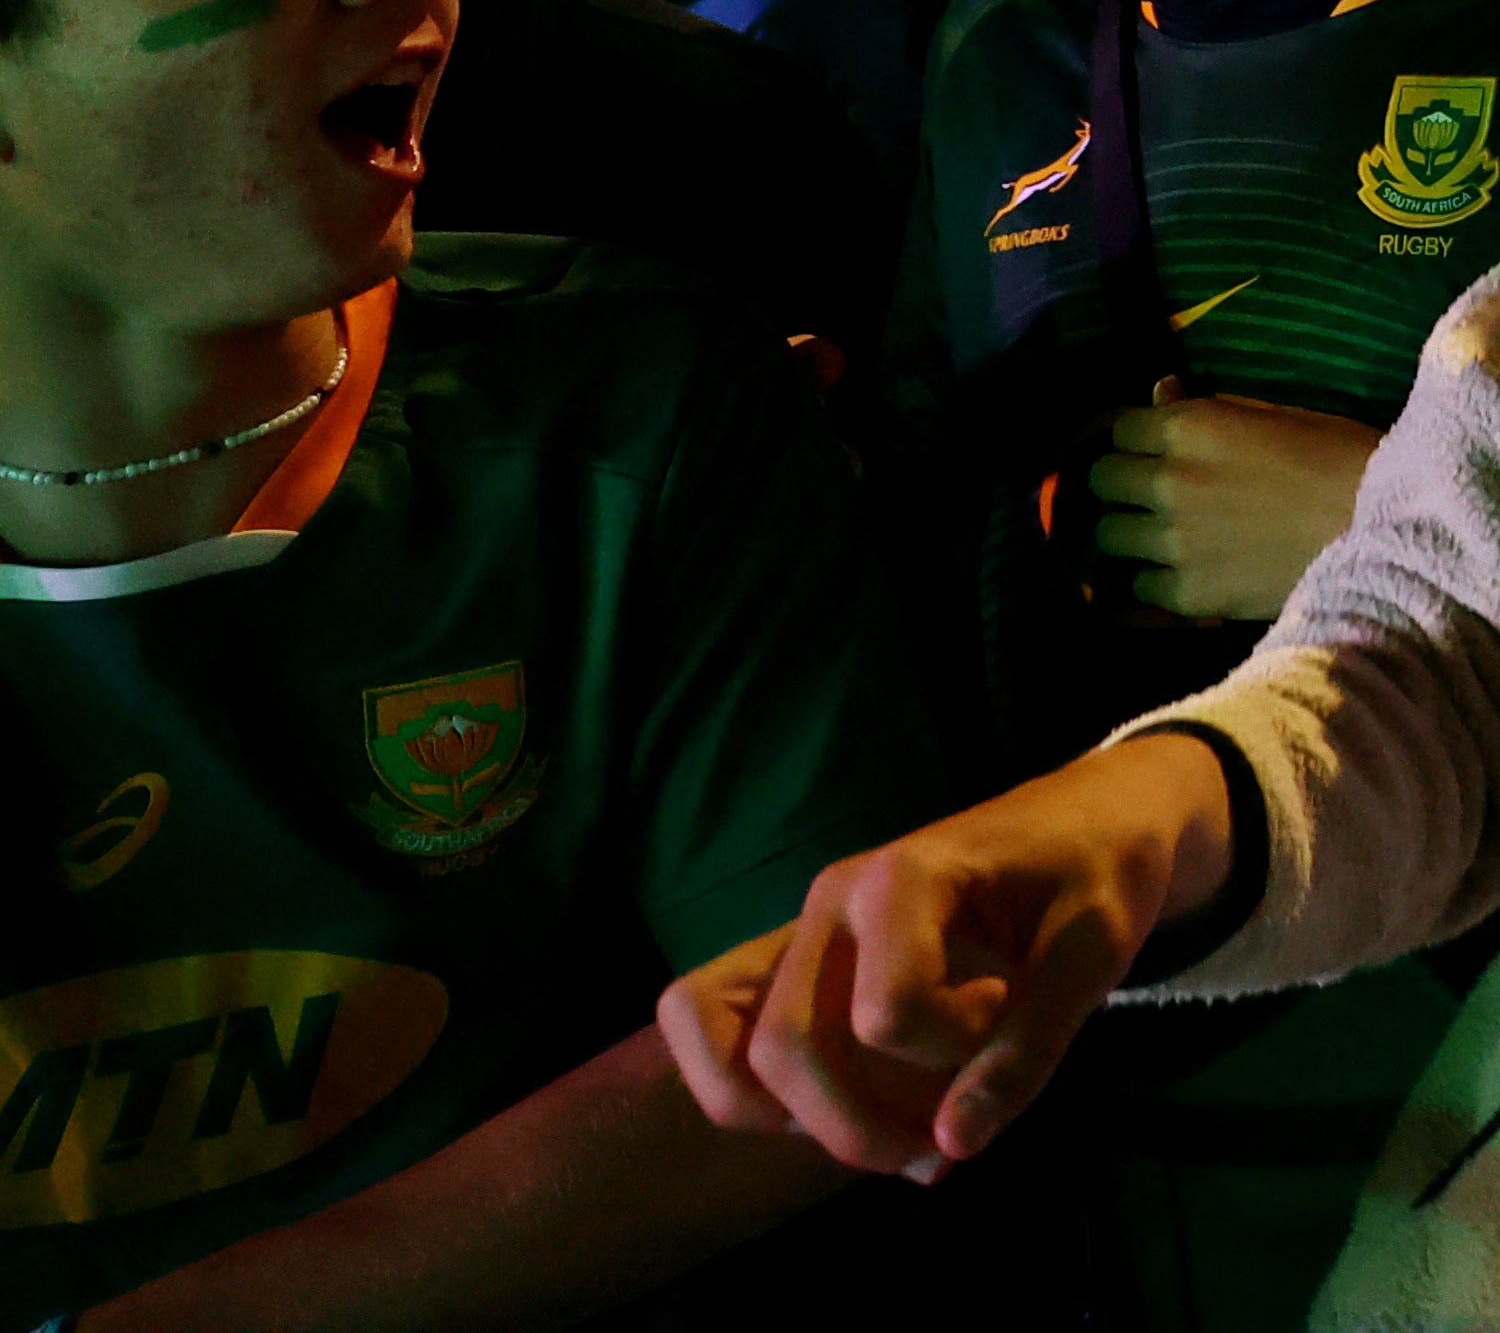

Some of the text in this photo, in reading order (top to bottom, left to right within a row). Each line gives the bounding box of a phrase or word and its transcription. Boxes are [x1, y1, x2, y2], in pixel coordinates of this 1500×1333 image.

[1382, 187, 1473, 214] SOUTH AFRICA
[1378, 233, 1455, 259] RUGBY
